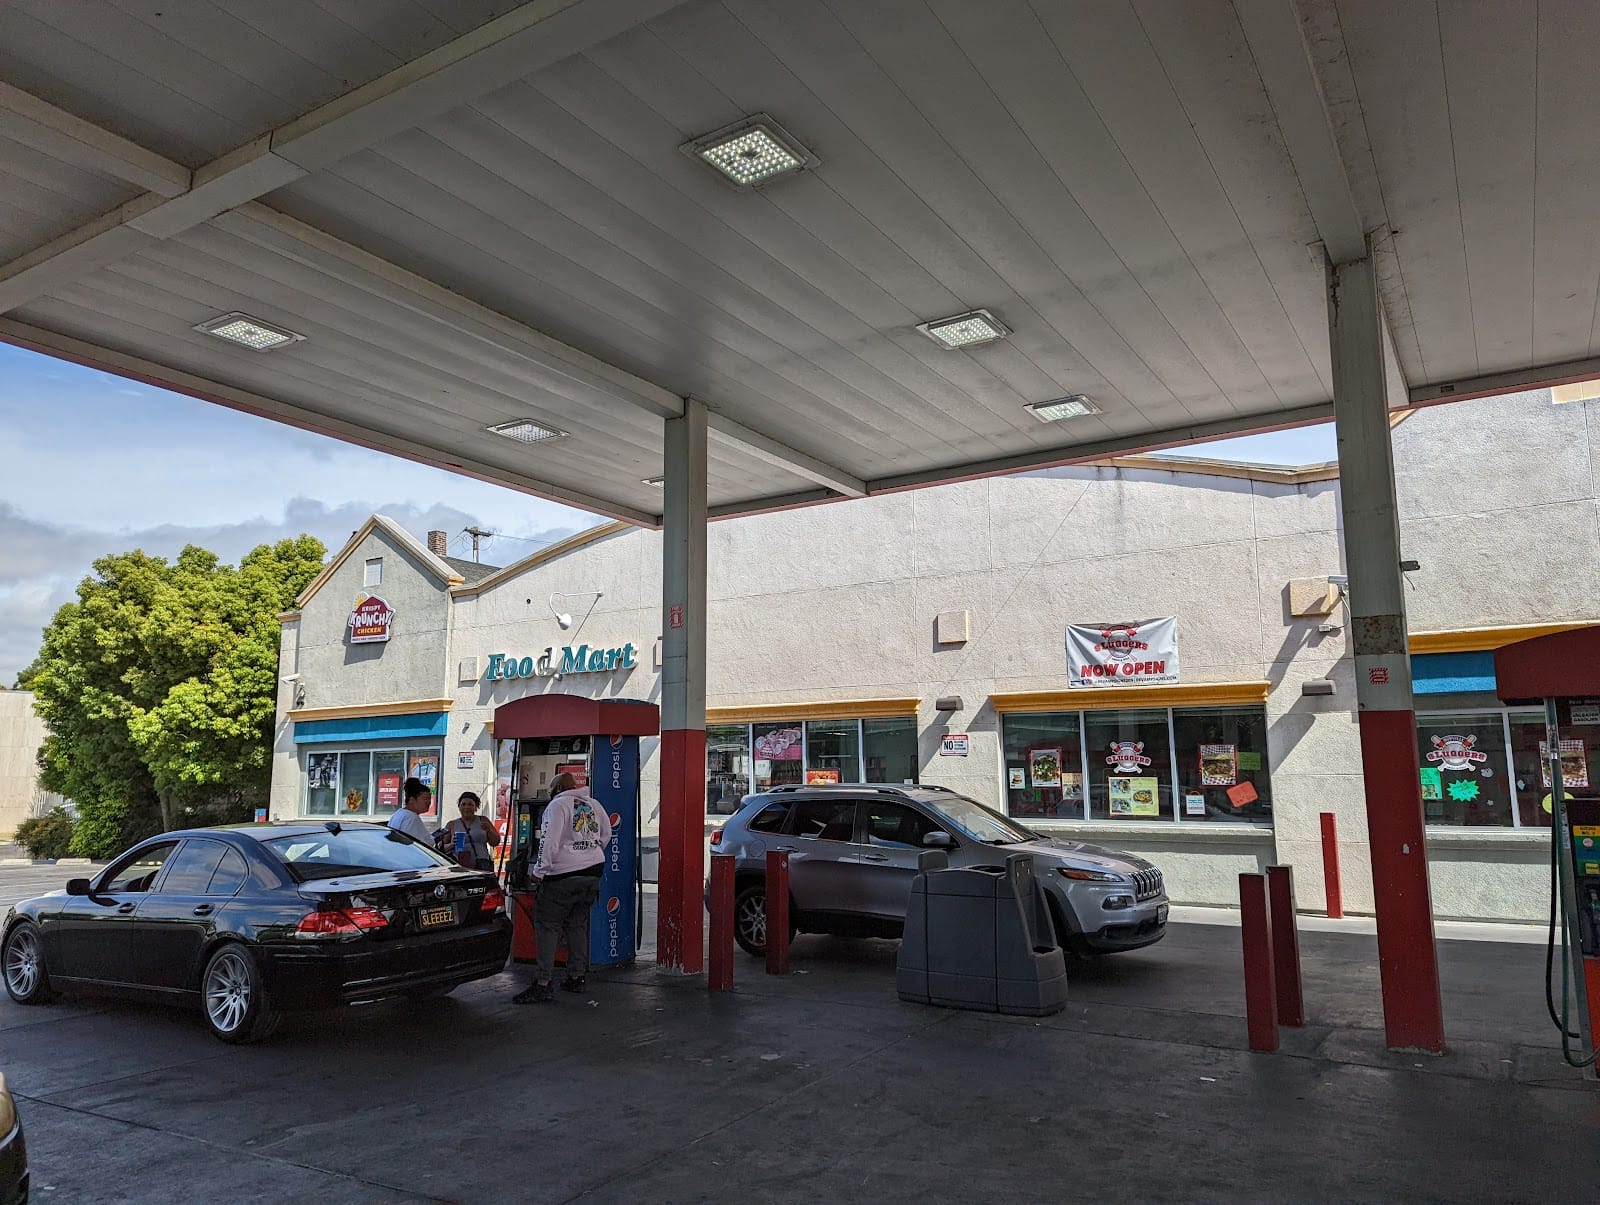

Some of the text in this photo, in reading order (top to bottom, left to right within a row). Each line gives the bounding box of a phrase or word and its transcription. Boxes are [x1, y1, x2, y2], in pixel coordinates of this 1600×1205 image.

[350, 610, 394, 627] KRUNCHY
[1094, 640, 1148, 651] SLUGGERS
[486, 642, 637, 680] Food Mart
[1081, 661, 1165, 677] NOW OPEN
[944, 741, 953, 750] NO
[1427, 751, 1485, 760] SLUGGERS
[612, 751, 620, 788] pepsi
[611, 830, 620, 872] pepsi
[422, 911, 453, 925] SLEEEEZ
[609, 919, 618, 957] pepsi
